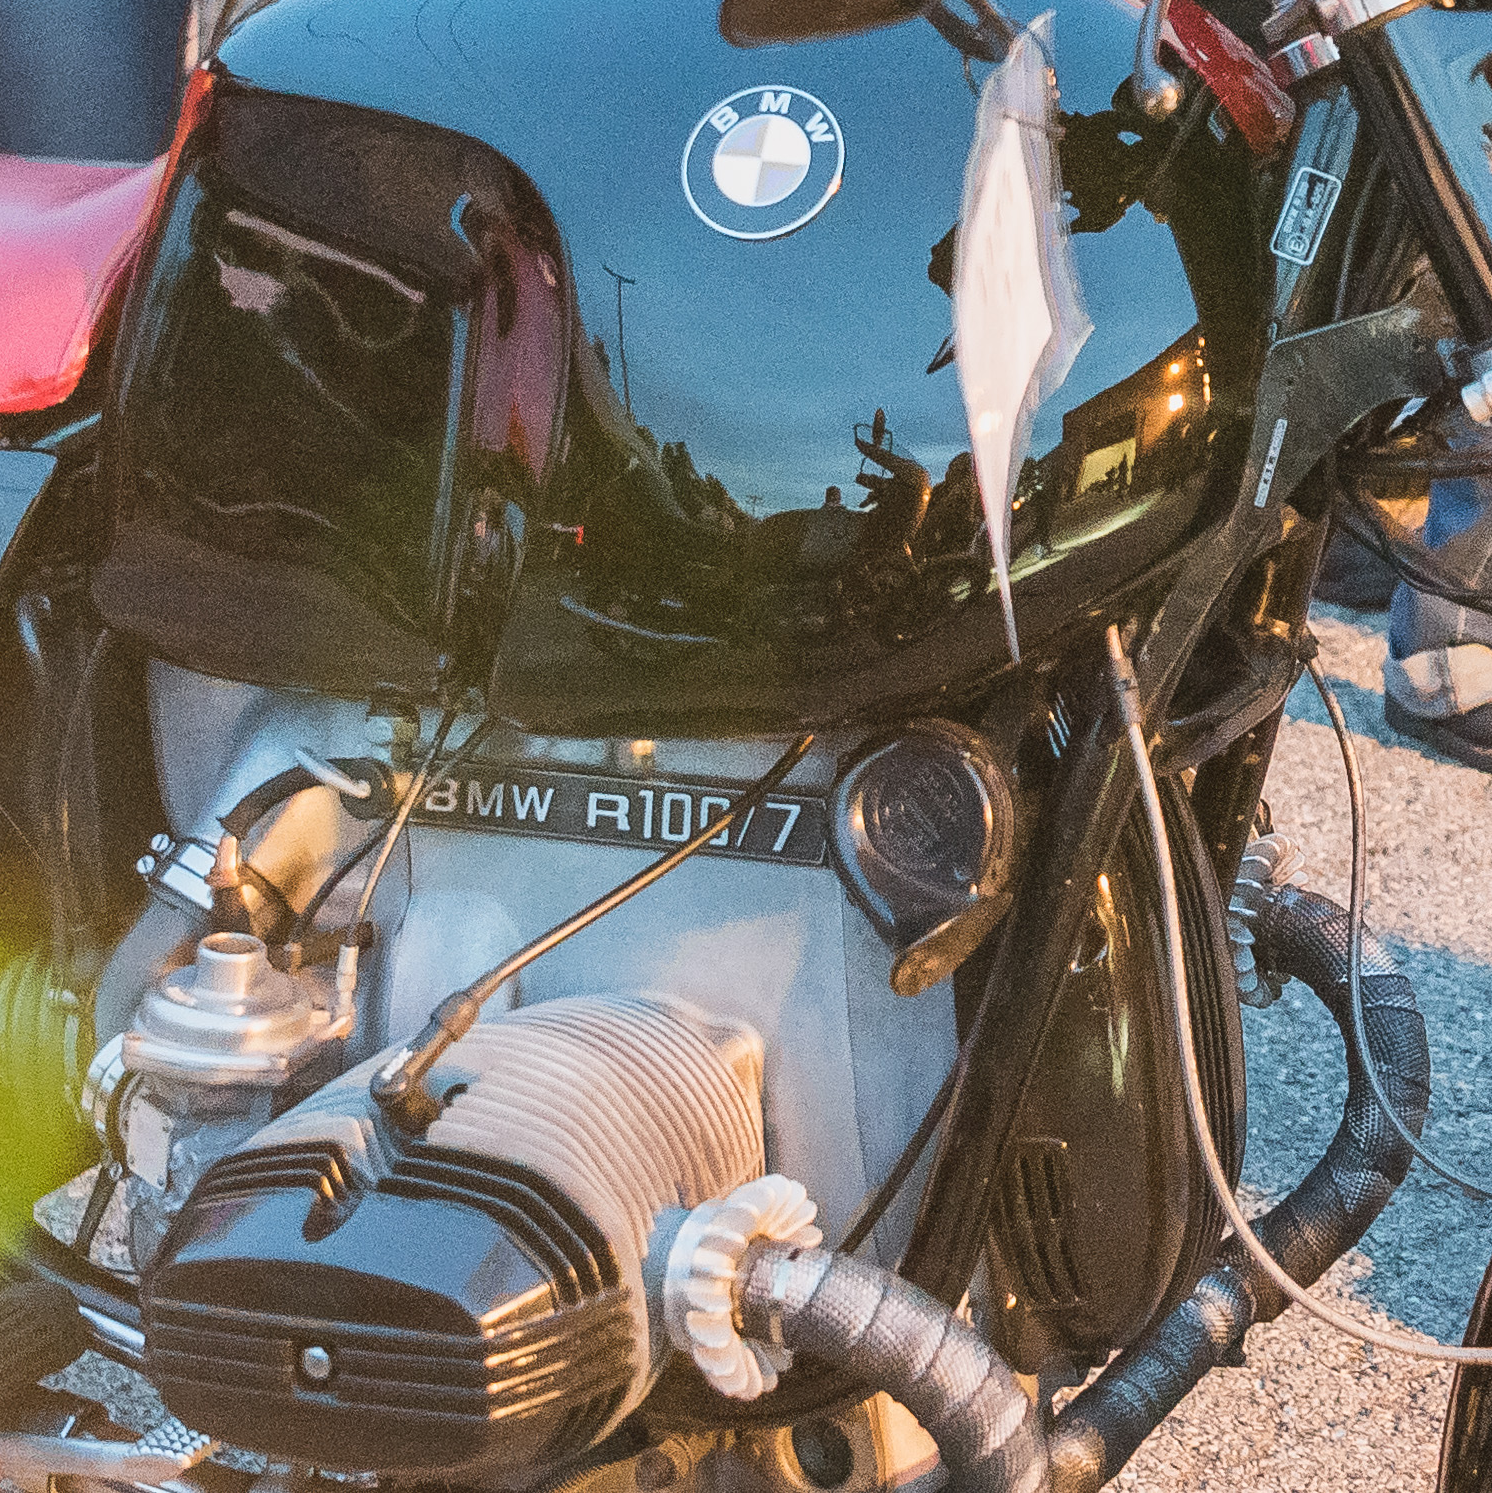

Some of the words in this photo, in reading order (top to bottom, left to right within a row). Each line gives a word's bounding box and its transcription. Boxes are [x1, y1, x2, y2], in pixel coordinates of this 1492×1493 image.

[709, 91, 835, 143] BMW
[424, 779, 555, 823] BMW
[586, 789, 802, 852] R100/7
